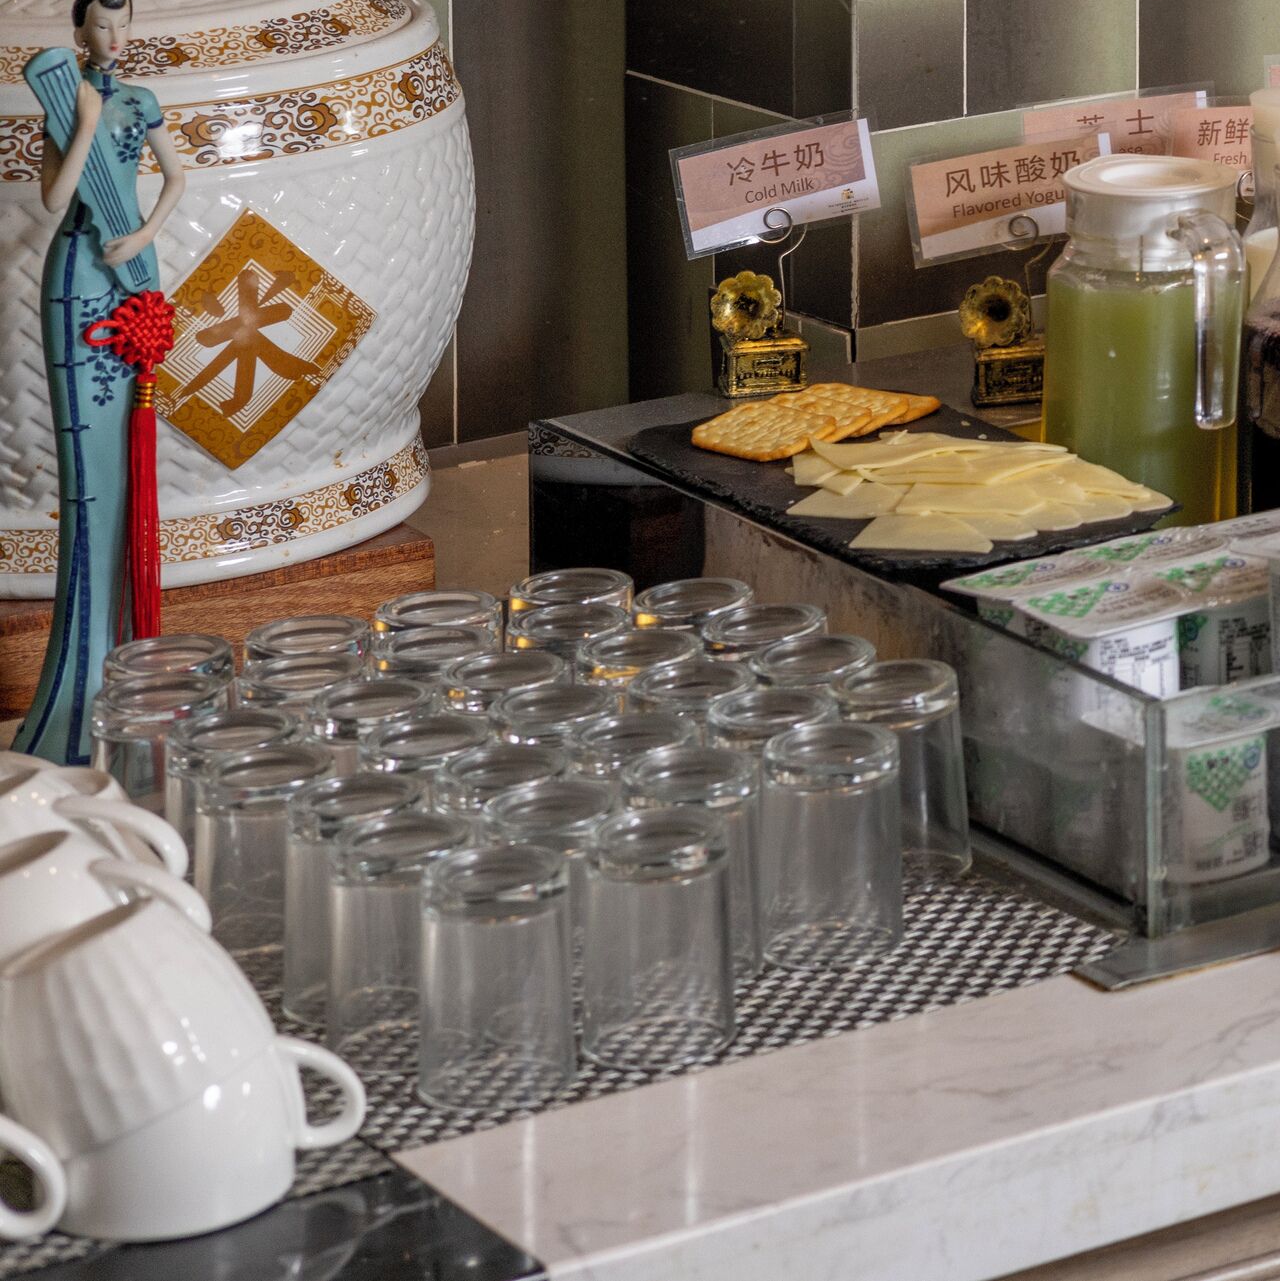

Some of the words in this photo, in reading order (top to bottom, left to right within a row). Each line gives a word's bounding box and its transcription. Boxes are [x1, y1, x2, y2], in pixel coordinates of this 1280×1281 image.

[1196, 117, 1250, 147] 新鲜
[726, 141, 826, 187] 冷牛奶
[1213, 151, 1247, 165] Fresh
[945, 150, 1081, 198] 风味酸奶
[744, 186, 778, 205] Cold
[780, 178, 815, 197] Milk
[952, 193, 1022, 219] Flavored
[177, 267, 327, 417] 米
